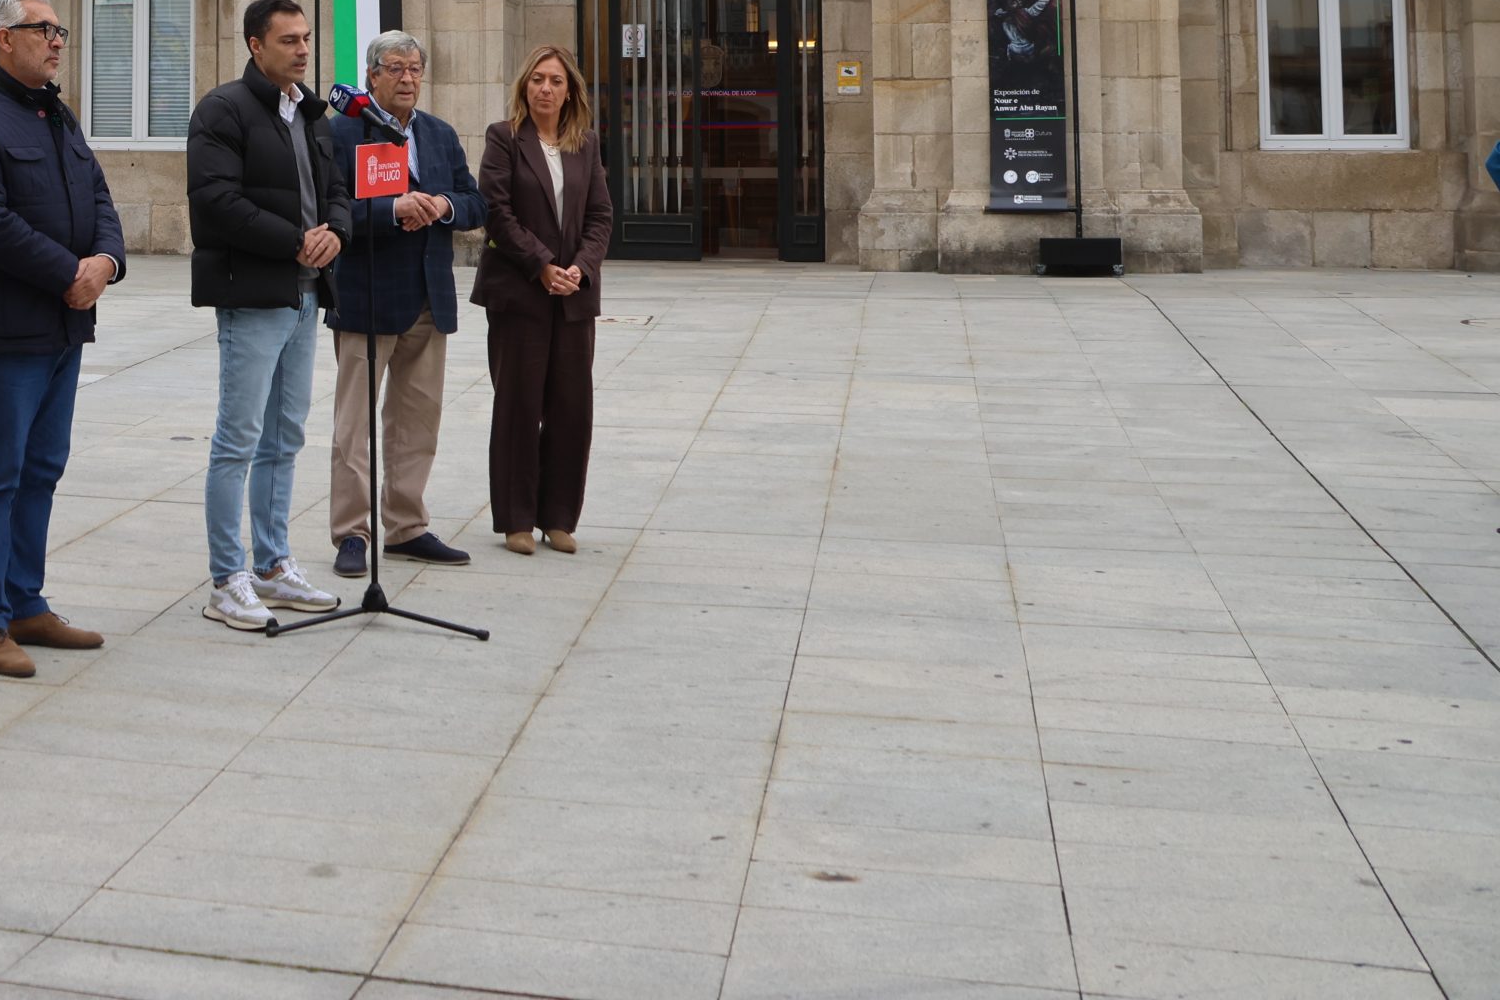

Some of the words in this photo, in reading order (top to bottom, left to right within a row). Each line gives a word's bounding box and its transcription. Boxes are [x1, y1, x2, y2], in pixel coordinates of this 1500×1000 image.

[994, 88, 1030, 96] Exposición
[1035, 104, 1057, 112] Rayan
[378, 161, 401, 170] DEPUTACIÓN
[383, 169, 401, 182] LUGO
